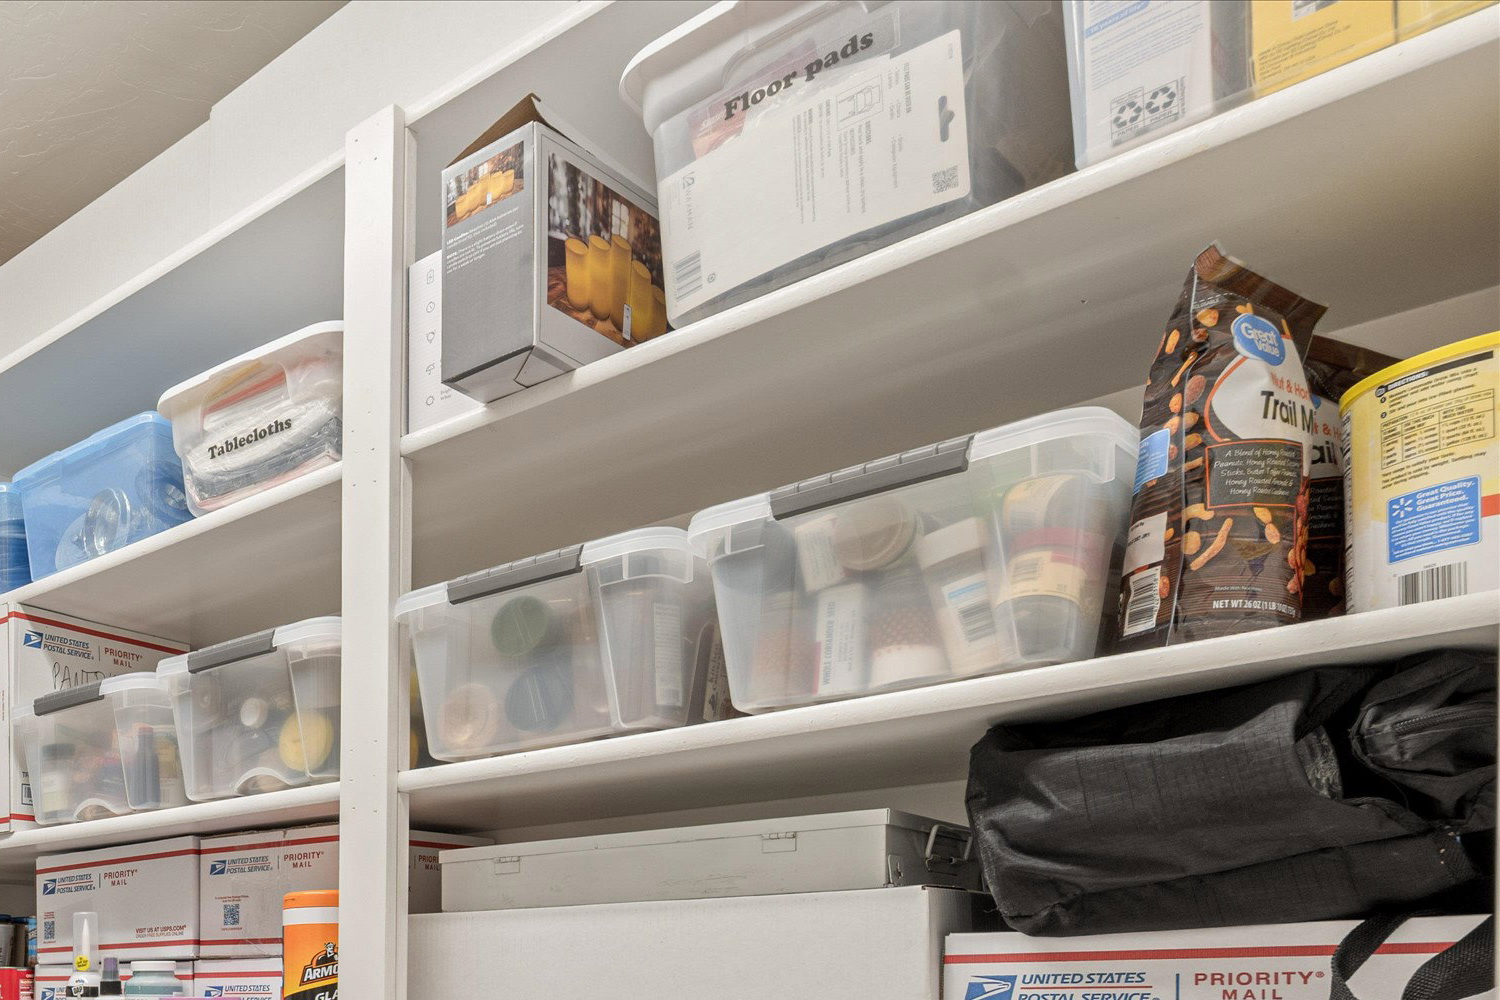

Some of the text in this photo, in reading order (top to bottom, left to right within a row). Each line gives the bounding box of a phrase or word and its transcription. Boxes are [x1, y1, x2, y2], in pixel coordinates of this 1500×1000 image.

[723, 29, 874, 122] Floor pads
[1241, 322, 1277, 345] Great
[1254, 338, 1280, 357] Value
[1260, 390, 1298, 428] Trail
[207, 416, 293, 461] Tablecloths
[1416, 480, 1476, 499] Great Quality.
[1213, 600, 1244, 610] NET WT
[44, 632, 90, 650] UNITED STATES
[43, 643, 92, 660] POSTAL SERVICE
[104, 646, 141, 661] PRIORITY
[113, 658, 132, 669] MAIL
[228, 855, 268, 866] UNITED STATES
[284, 851, 322, 862] PRIORITY
[226, 864, 270, 875] POSTAL SERVICE
[292, 860, 312, 869] MAIL
[57, 873, 92, 885] UNITED STATES
[104, 869, 135, 880] PRIORITY
[56, 883, 93, 895] POSTAL SERVICE
[111, 878, 127, 887] MAIL
[304, 965, 338, 982] ARMO
[1019, 970, 1147, 987] UNITED STATES
[1194, 970, 1315, 987] PRIORITY
[224, 984, 270, 993] UNITED STATES
[1221, 988, 1285, 1000] MAIL
